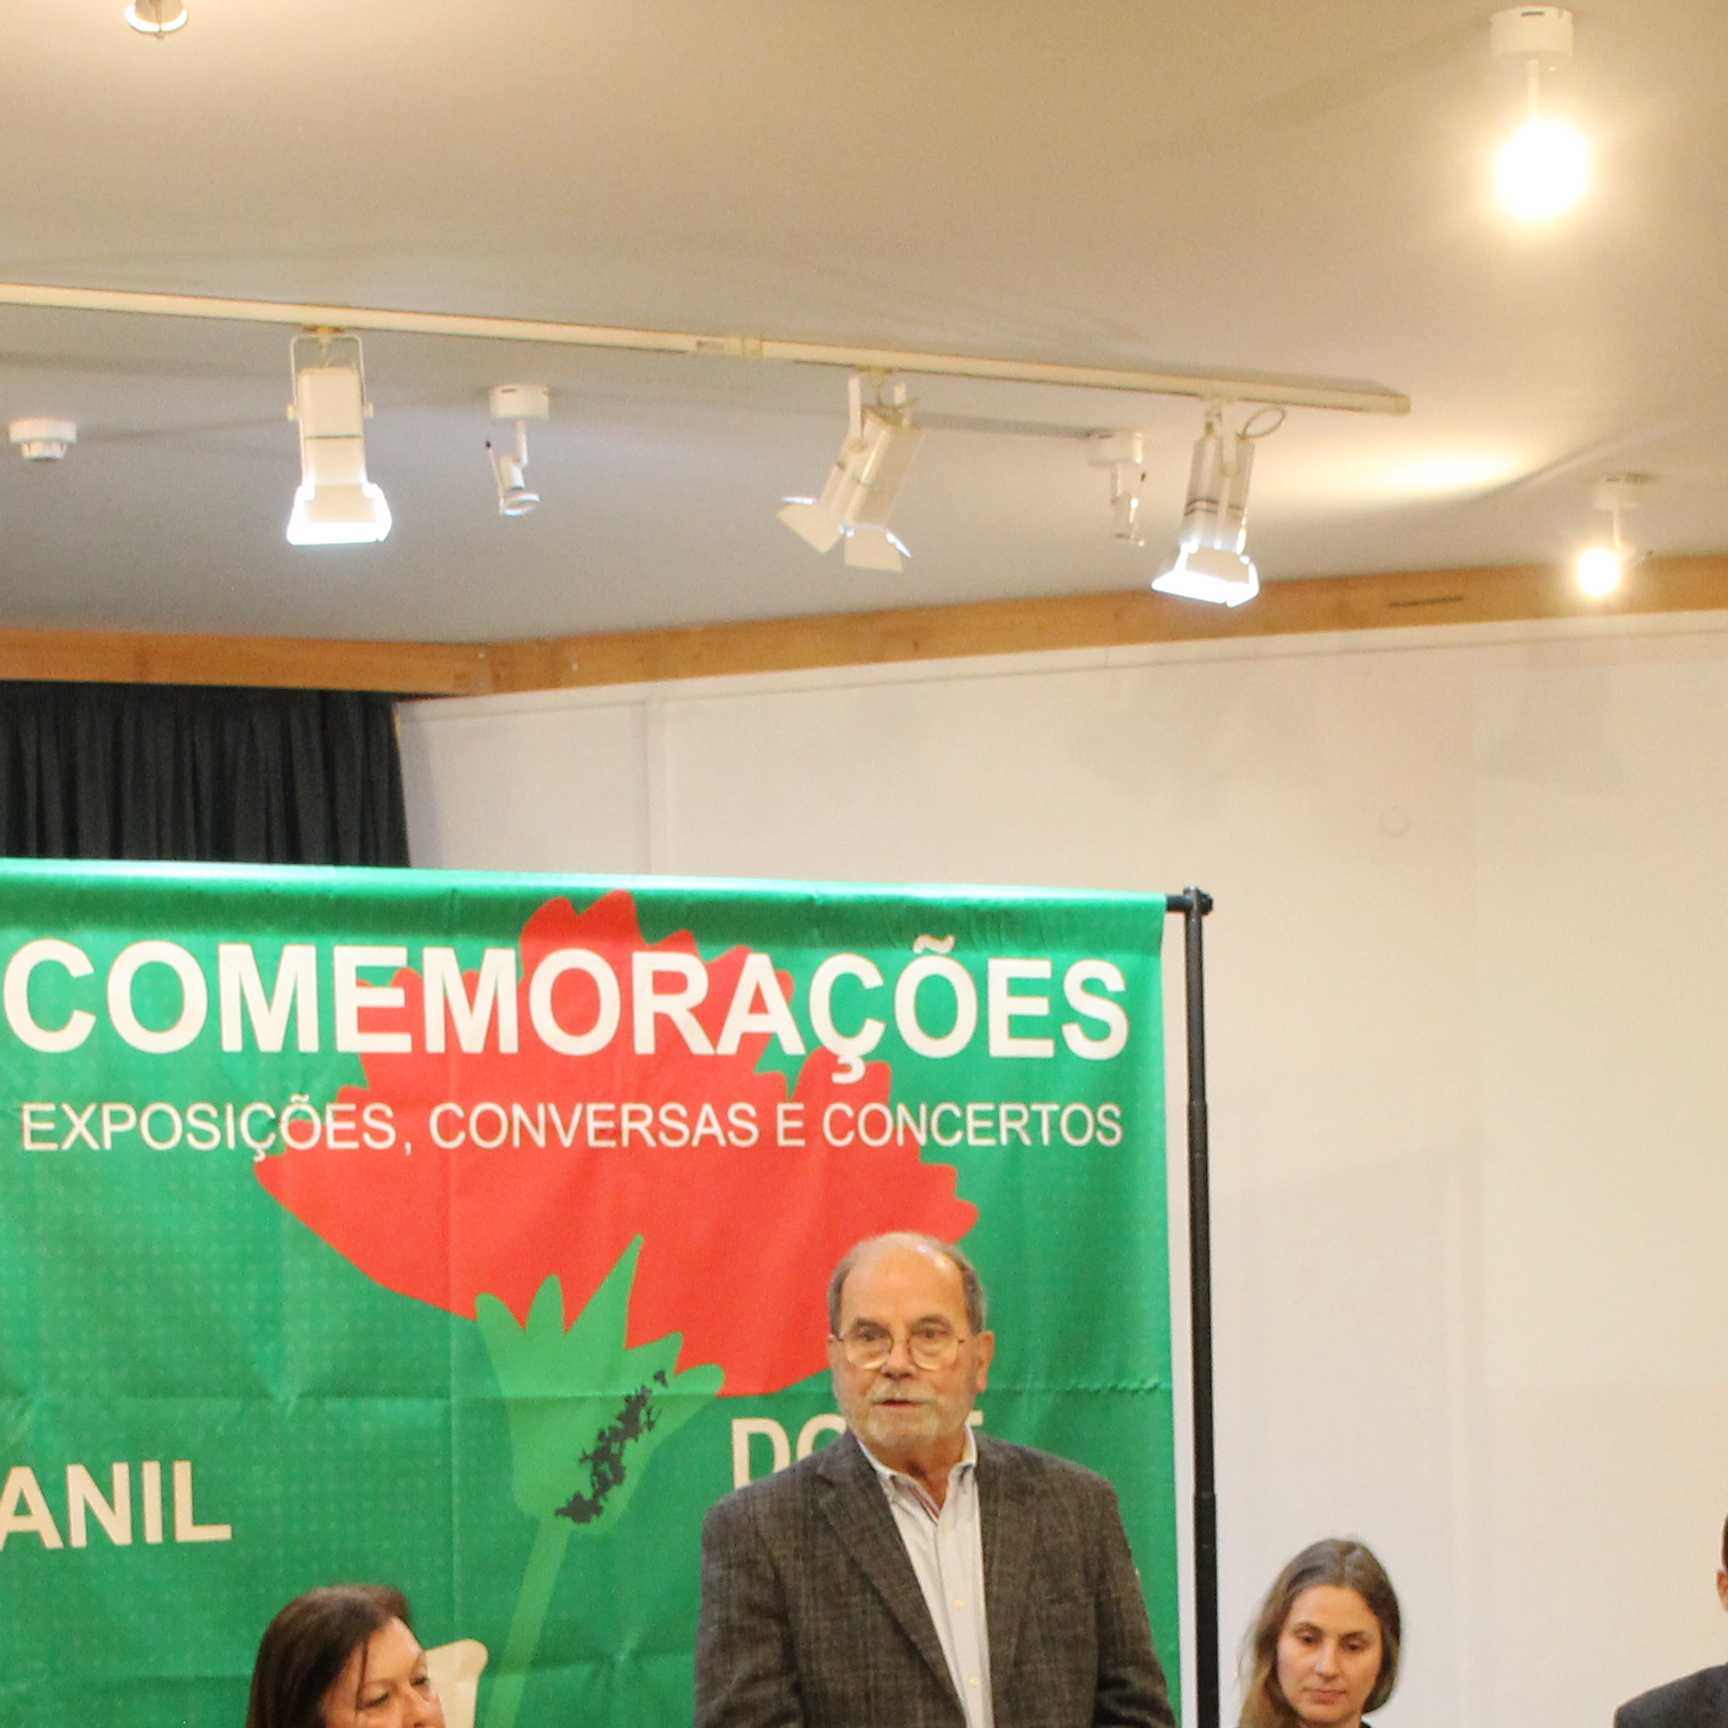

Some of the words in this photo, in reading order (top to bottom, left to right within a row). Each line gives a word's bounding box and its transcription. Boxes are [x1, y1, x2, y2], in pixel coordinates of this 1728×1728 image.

[2, 934, 1131, 1084] COMEMORAÇÕES
[20, 1093, 413, 1161] EXPOSIÇÕES,
[427, 1101, 761, 1151] CONVERSAS
[775, 1101, 807, 1148] E
[821, 1101, 1125, 1148] CONCERTOS
